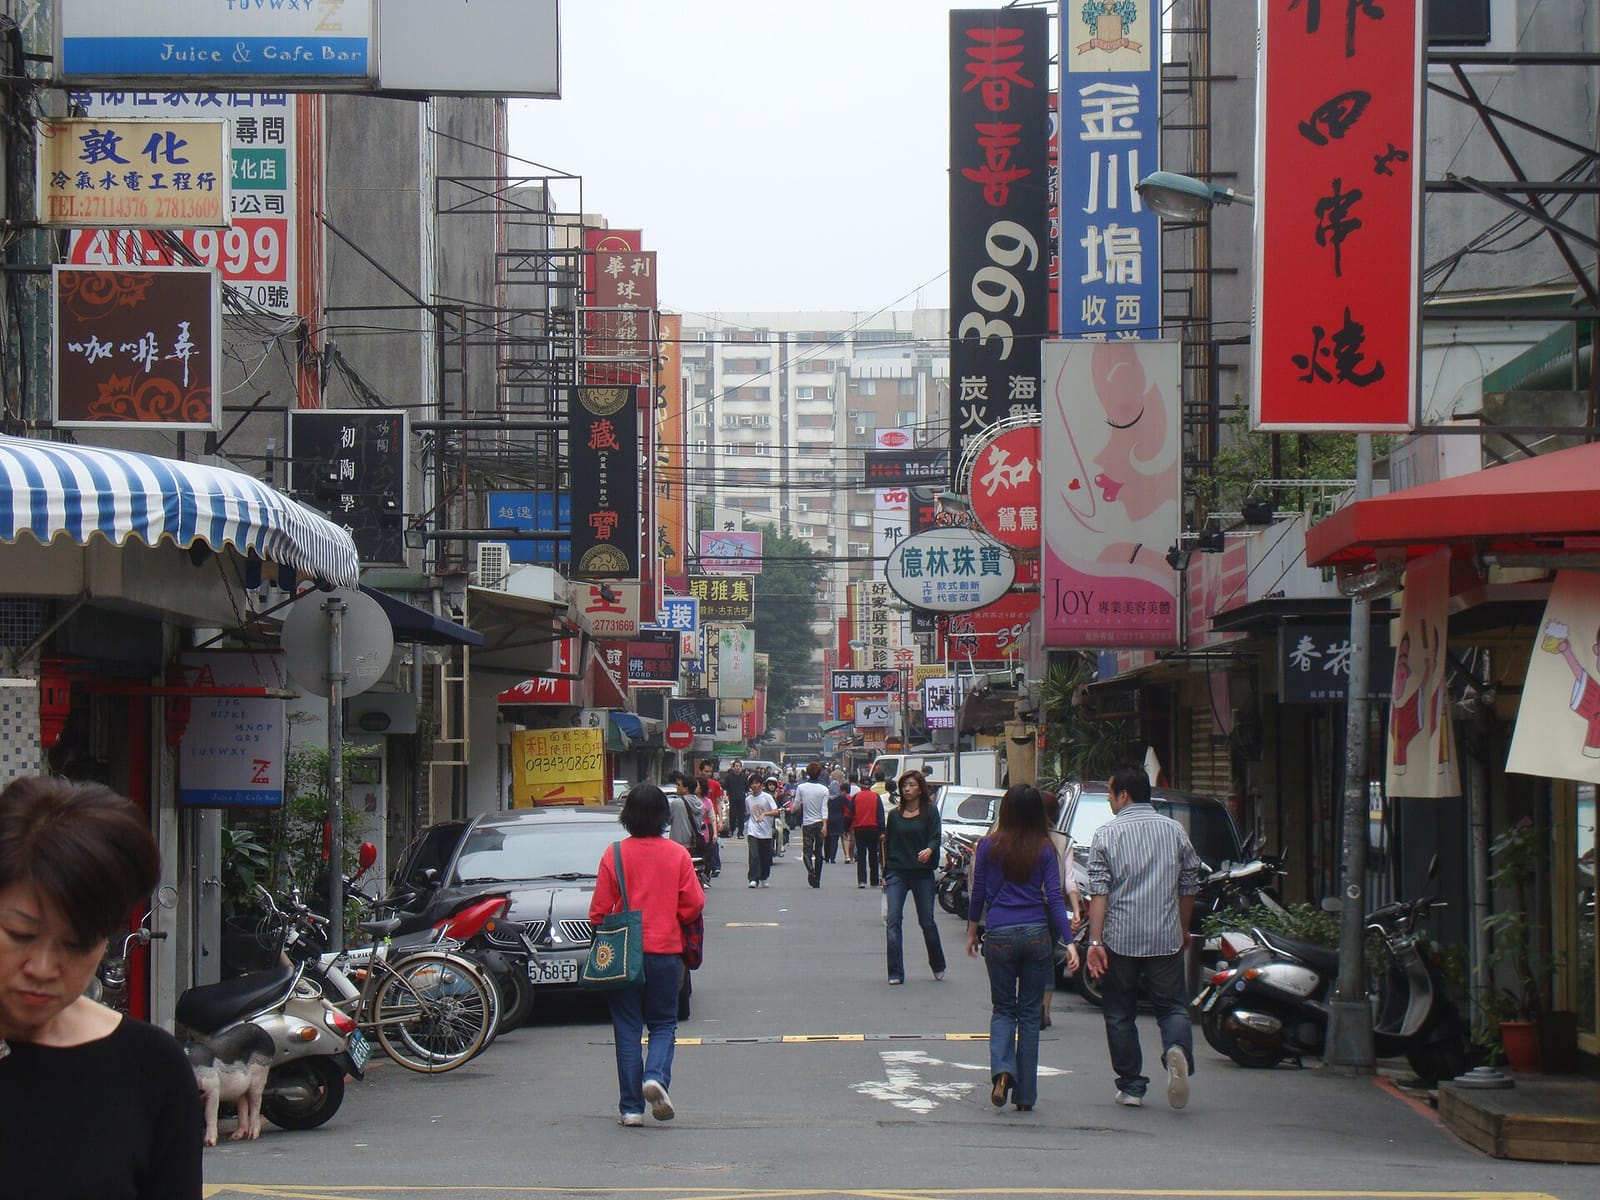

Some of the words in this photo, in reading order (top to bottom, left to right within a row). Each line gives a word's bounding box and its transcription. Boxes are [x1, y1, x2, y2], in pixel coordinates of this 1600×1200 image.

[160, 43, 222, 62] Juice
[232, 41, 252, 63] &
[263, 45, 314, 61] Cafe
[322, 45, 361, 60] Bar
[79, 129, 190, 165] 敦化
[50, 171, 217, 191] 冷氣水電工程行
[231, 194, 285, 214] 公司
[958, 220, 1039, 360] 399
[899, 545, 1003, 579] 億林珠寶
[834, 674, 881, 689] 哈麻辣
